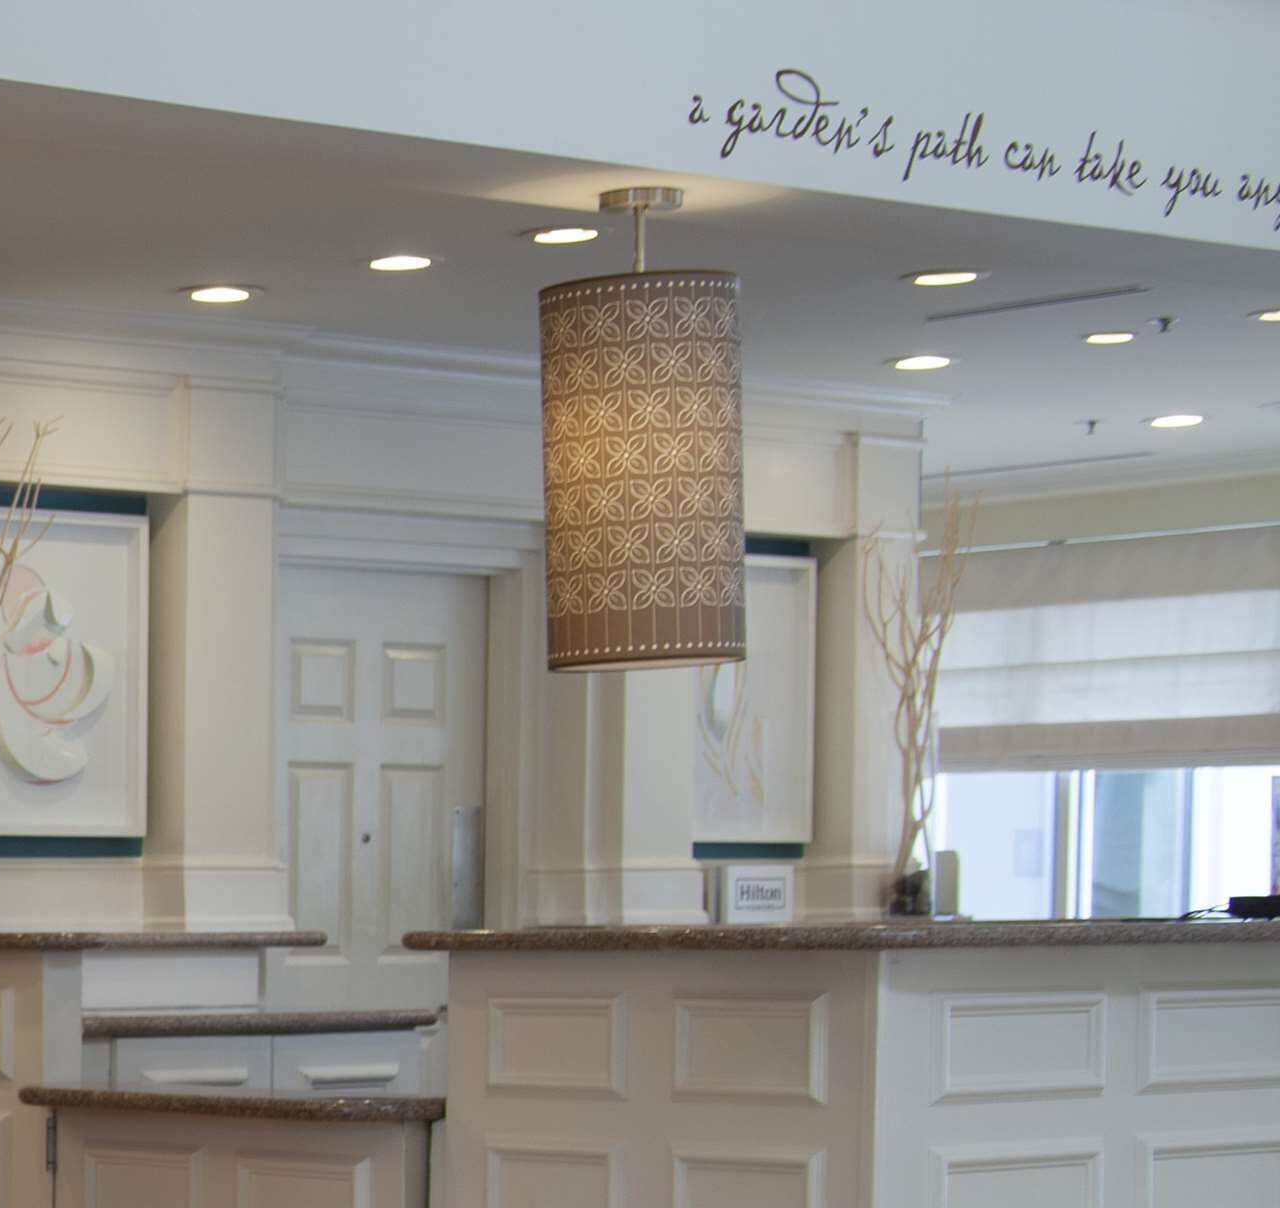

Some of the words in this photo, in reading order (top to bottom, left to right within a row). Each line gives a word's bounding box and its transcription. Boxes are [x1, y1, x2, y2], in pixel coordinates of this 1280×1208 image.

[688, 94, 710, 125] a
[719, 68, 895, 159] garden's
[902, 111, 990, 183] path
[1003, 140, 1062, 183] can
[1073, 130, 1147, 197] take
[1160, 166, 1223, 217] you
[739, 883, 782, 902] Hilton
